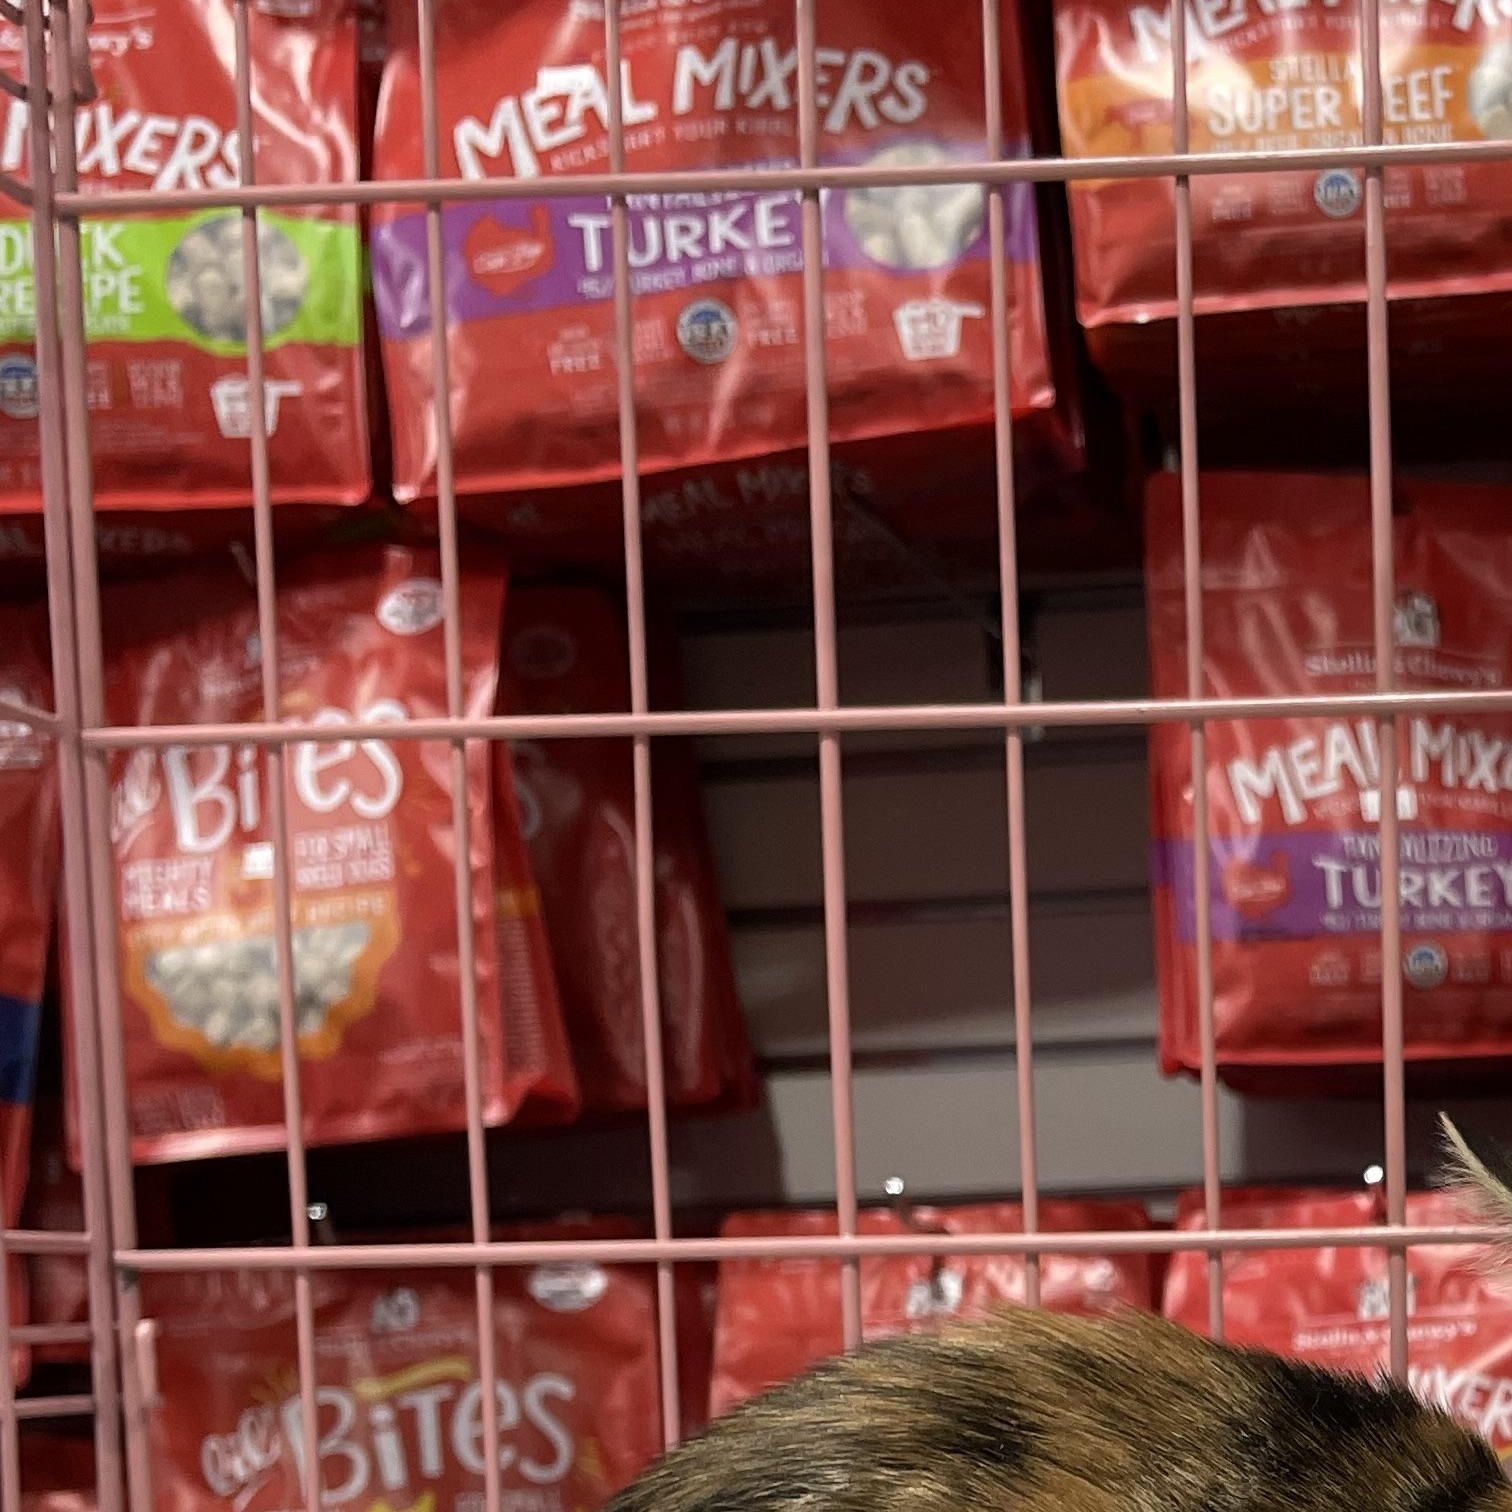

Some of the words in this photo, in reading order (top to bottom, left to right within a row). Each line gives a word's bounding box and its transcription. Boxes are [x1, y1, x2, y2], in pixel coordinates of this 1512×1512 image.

[454, 58, 658, 180] MEAL
[672, 38, 930, 133] MIXERS
[1207, 84, 1343, 137] SUPER
[1359, 66, 1455, 125] EEF
[0, 222, 126, 275] DK
[1226, 719, 1386, 825] MEAL
